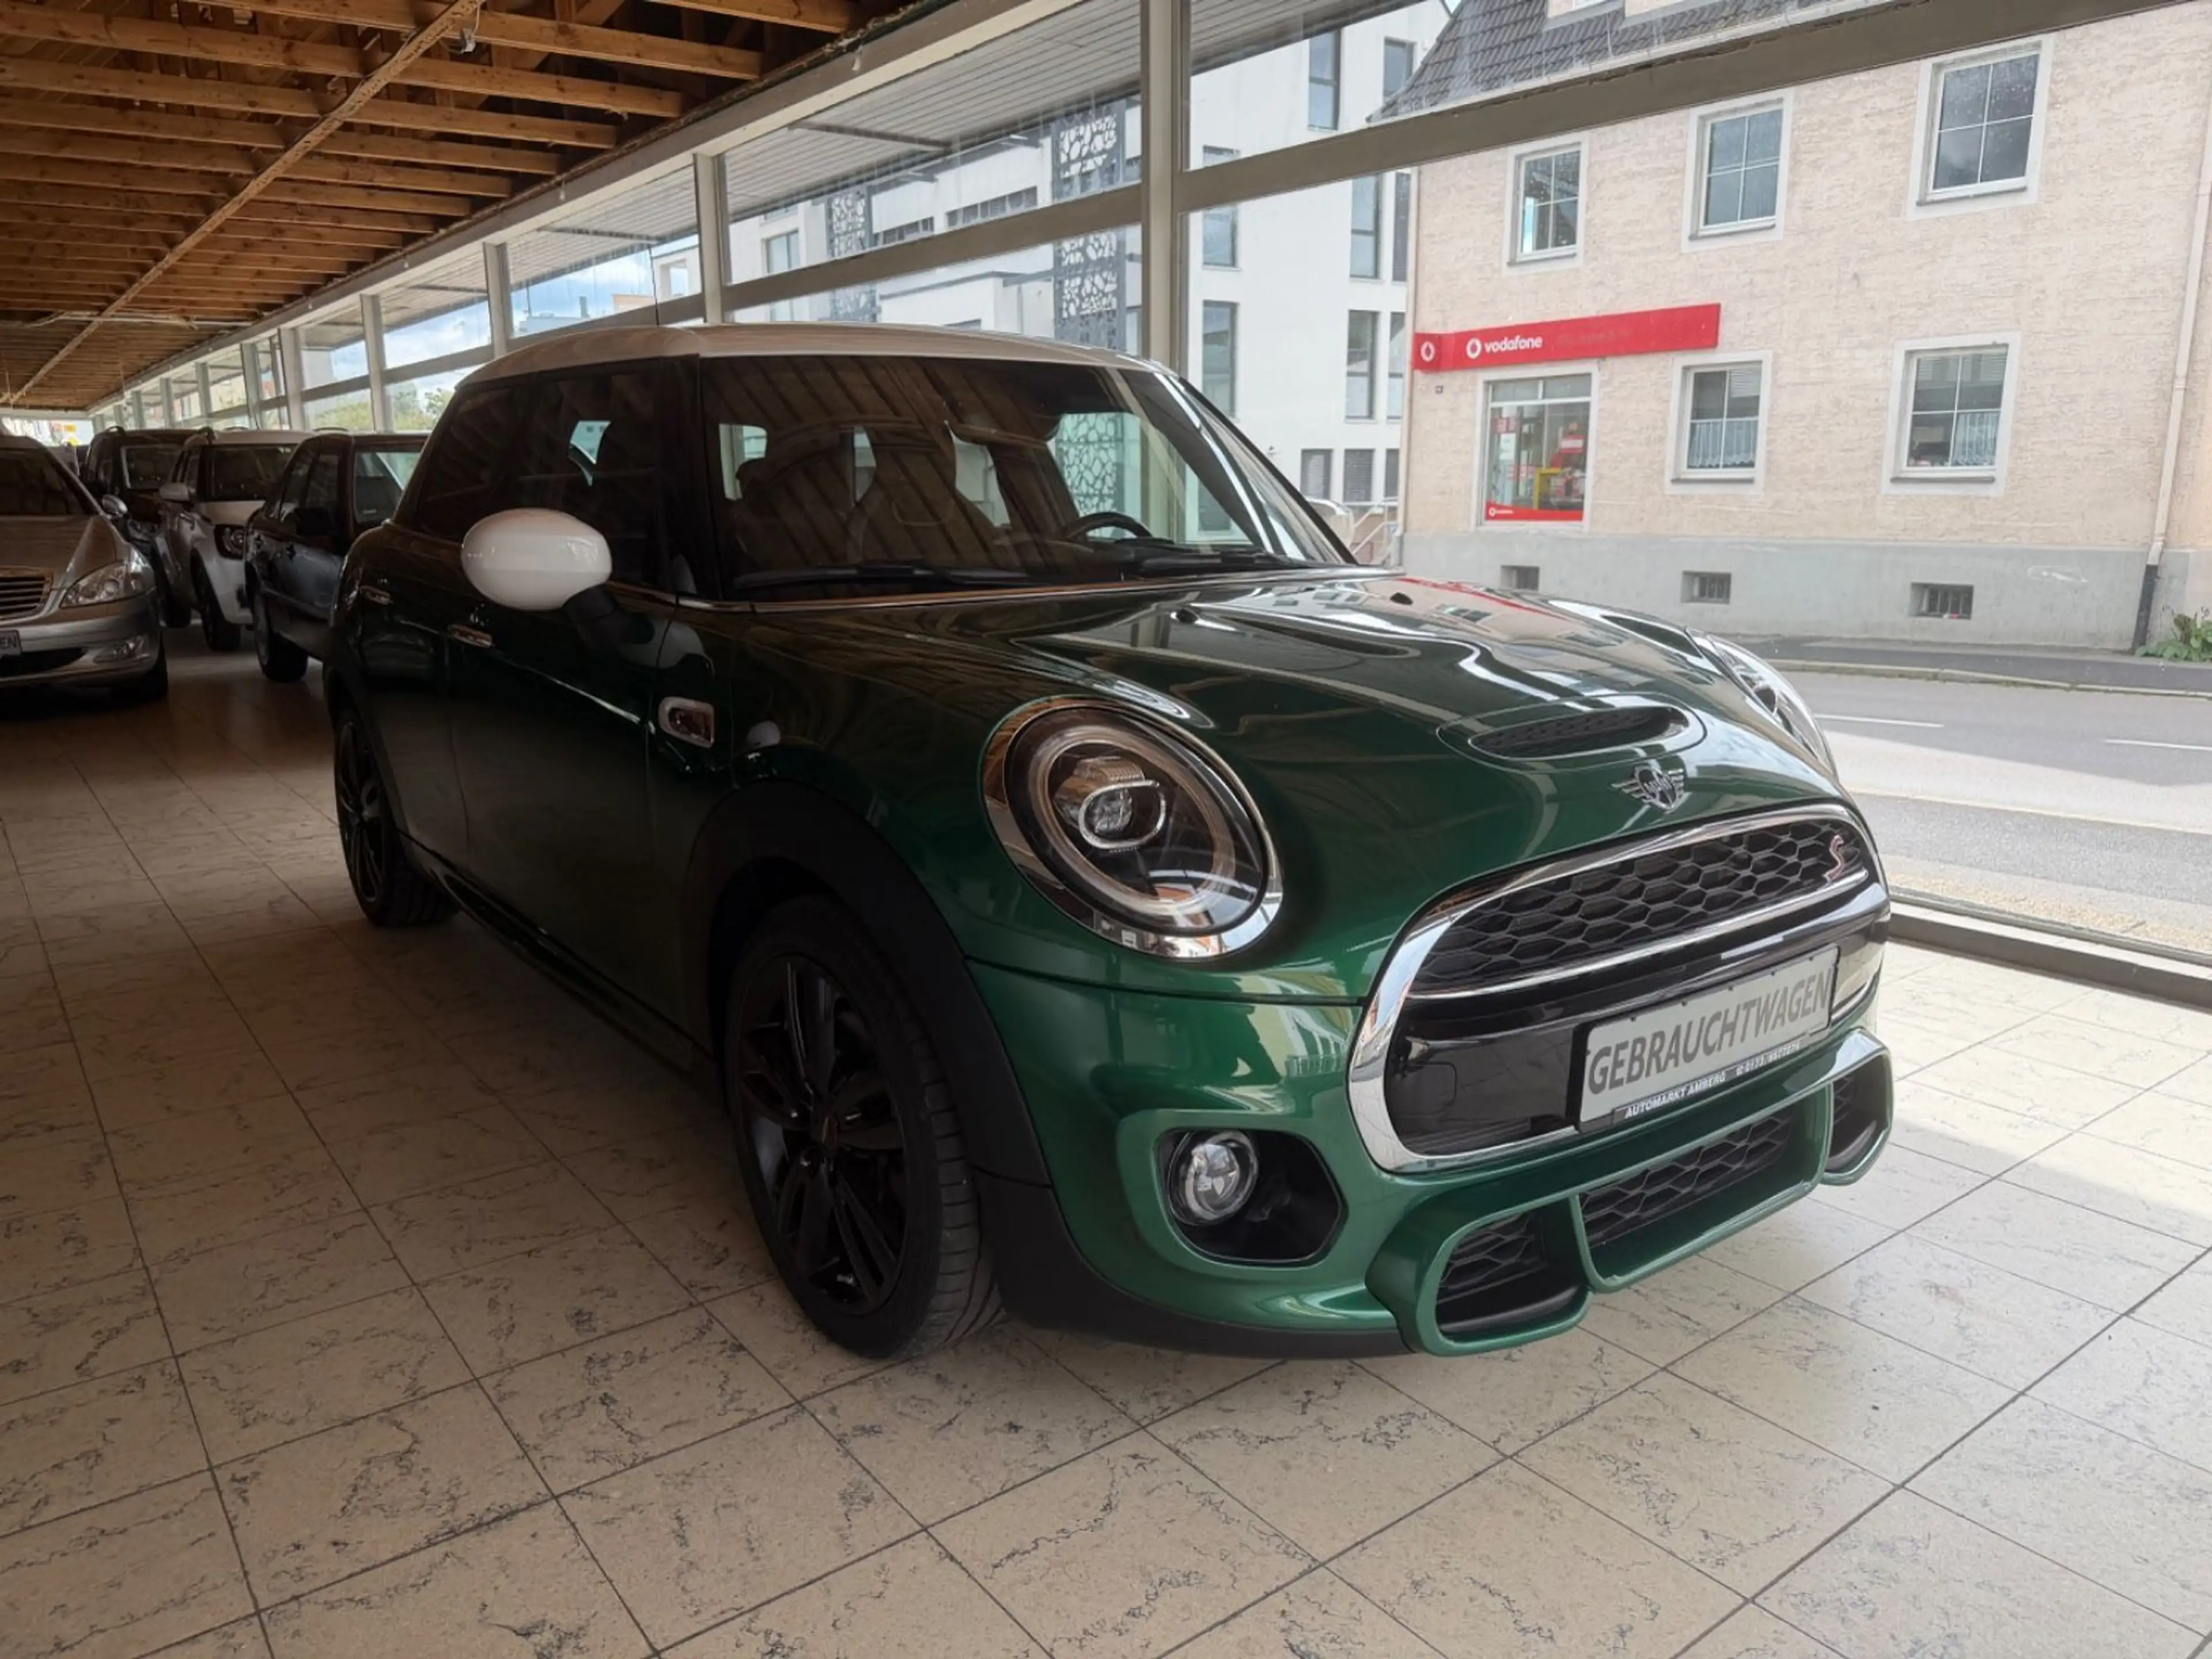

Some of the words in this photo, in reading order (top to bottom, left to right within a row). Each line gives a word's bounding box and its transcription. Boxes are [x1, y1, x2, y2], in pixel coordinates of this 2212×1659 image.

[1484, 335, 1543, 353] vodafone
[1589, 969, 1832, 1094] GEBRAUCHTWAGEN
[1624, 1088, 1687, 1119] AUTOMARKT
